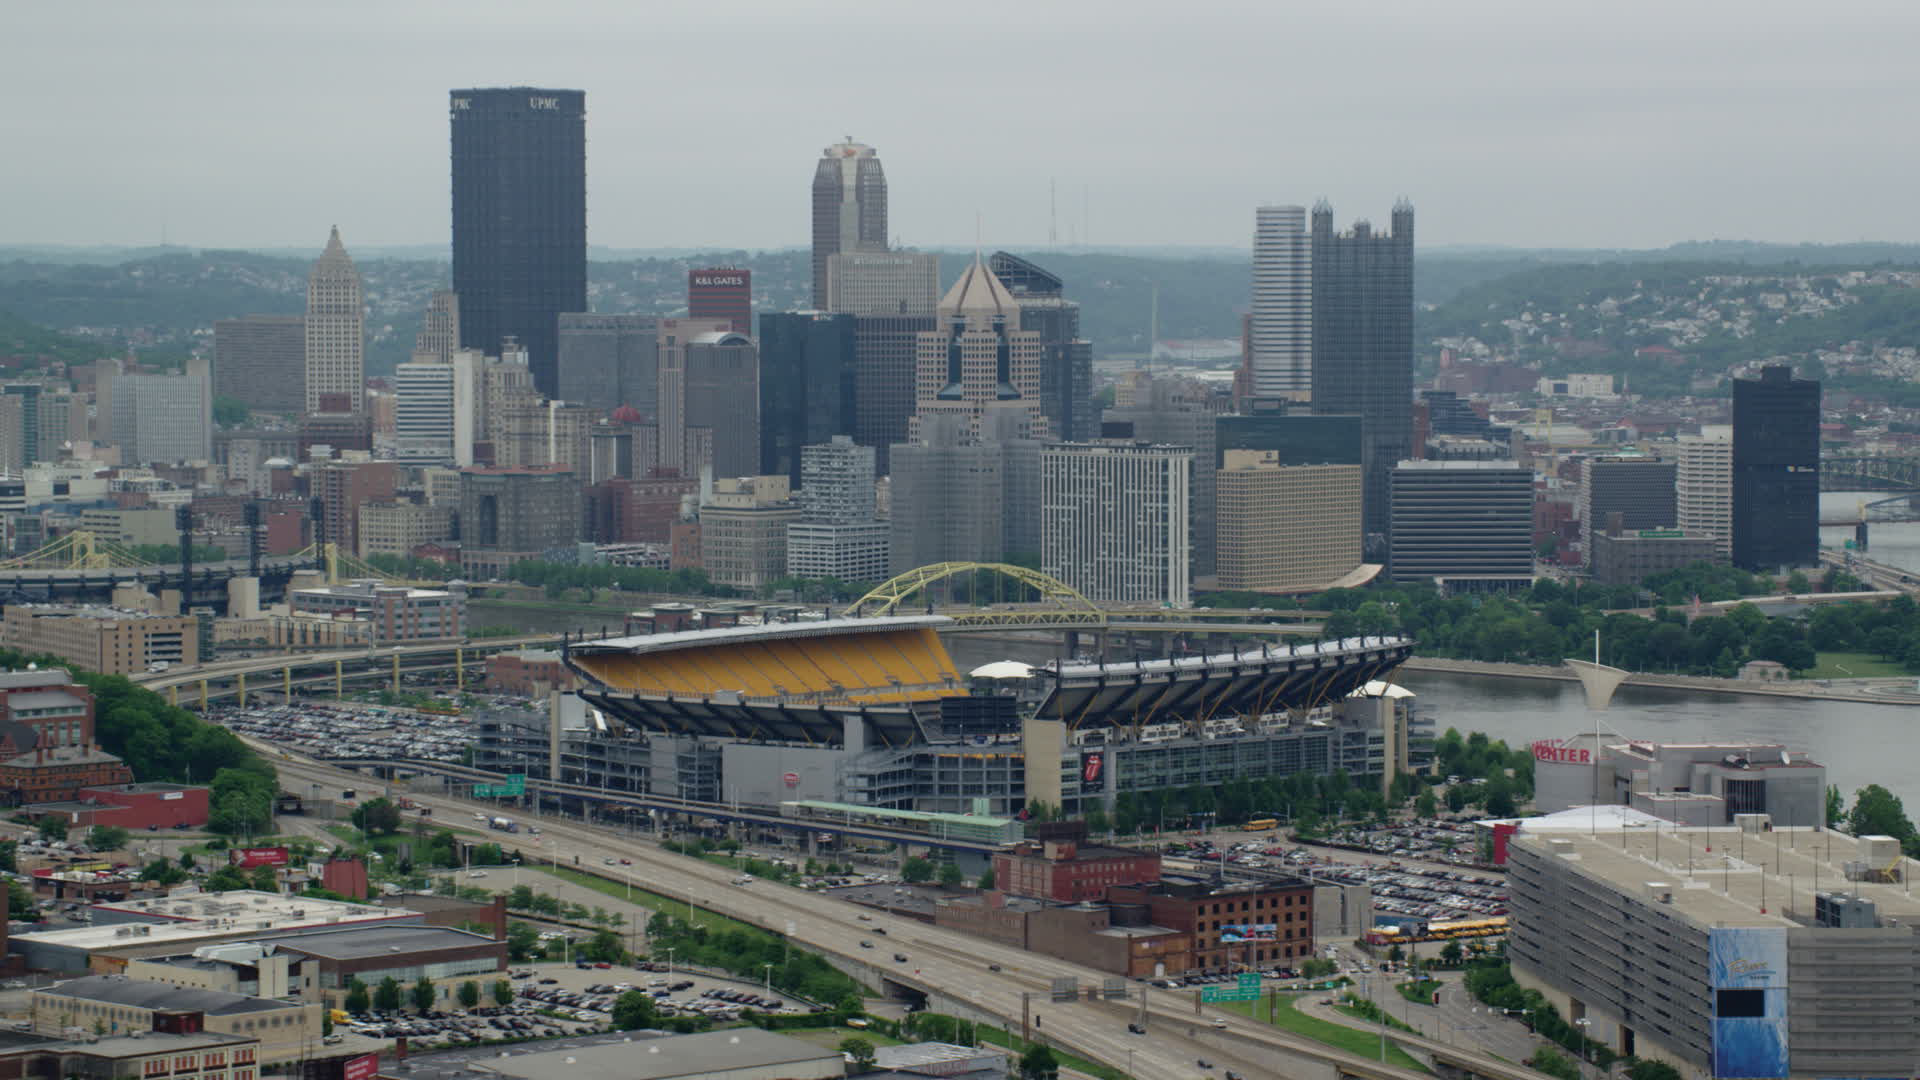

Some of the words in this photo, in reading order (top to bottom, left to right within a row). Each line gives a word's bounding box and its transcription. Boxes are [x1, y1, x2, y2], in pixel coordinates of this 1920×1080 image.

[530, 97, 559, 110] UPMC
[713, 276, 743, 286] GATES
[1534, 746, 1591, 763] CENTER
